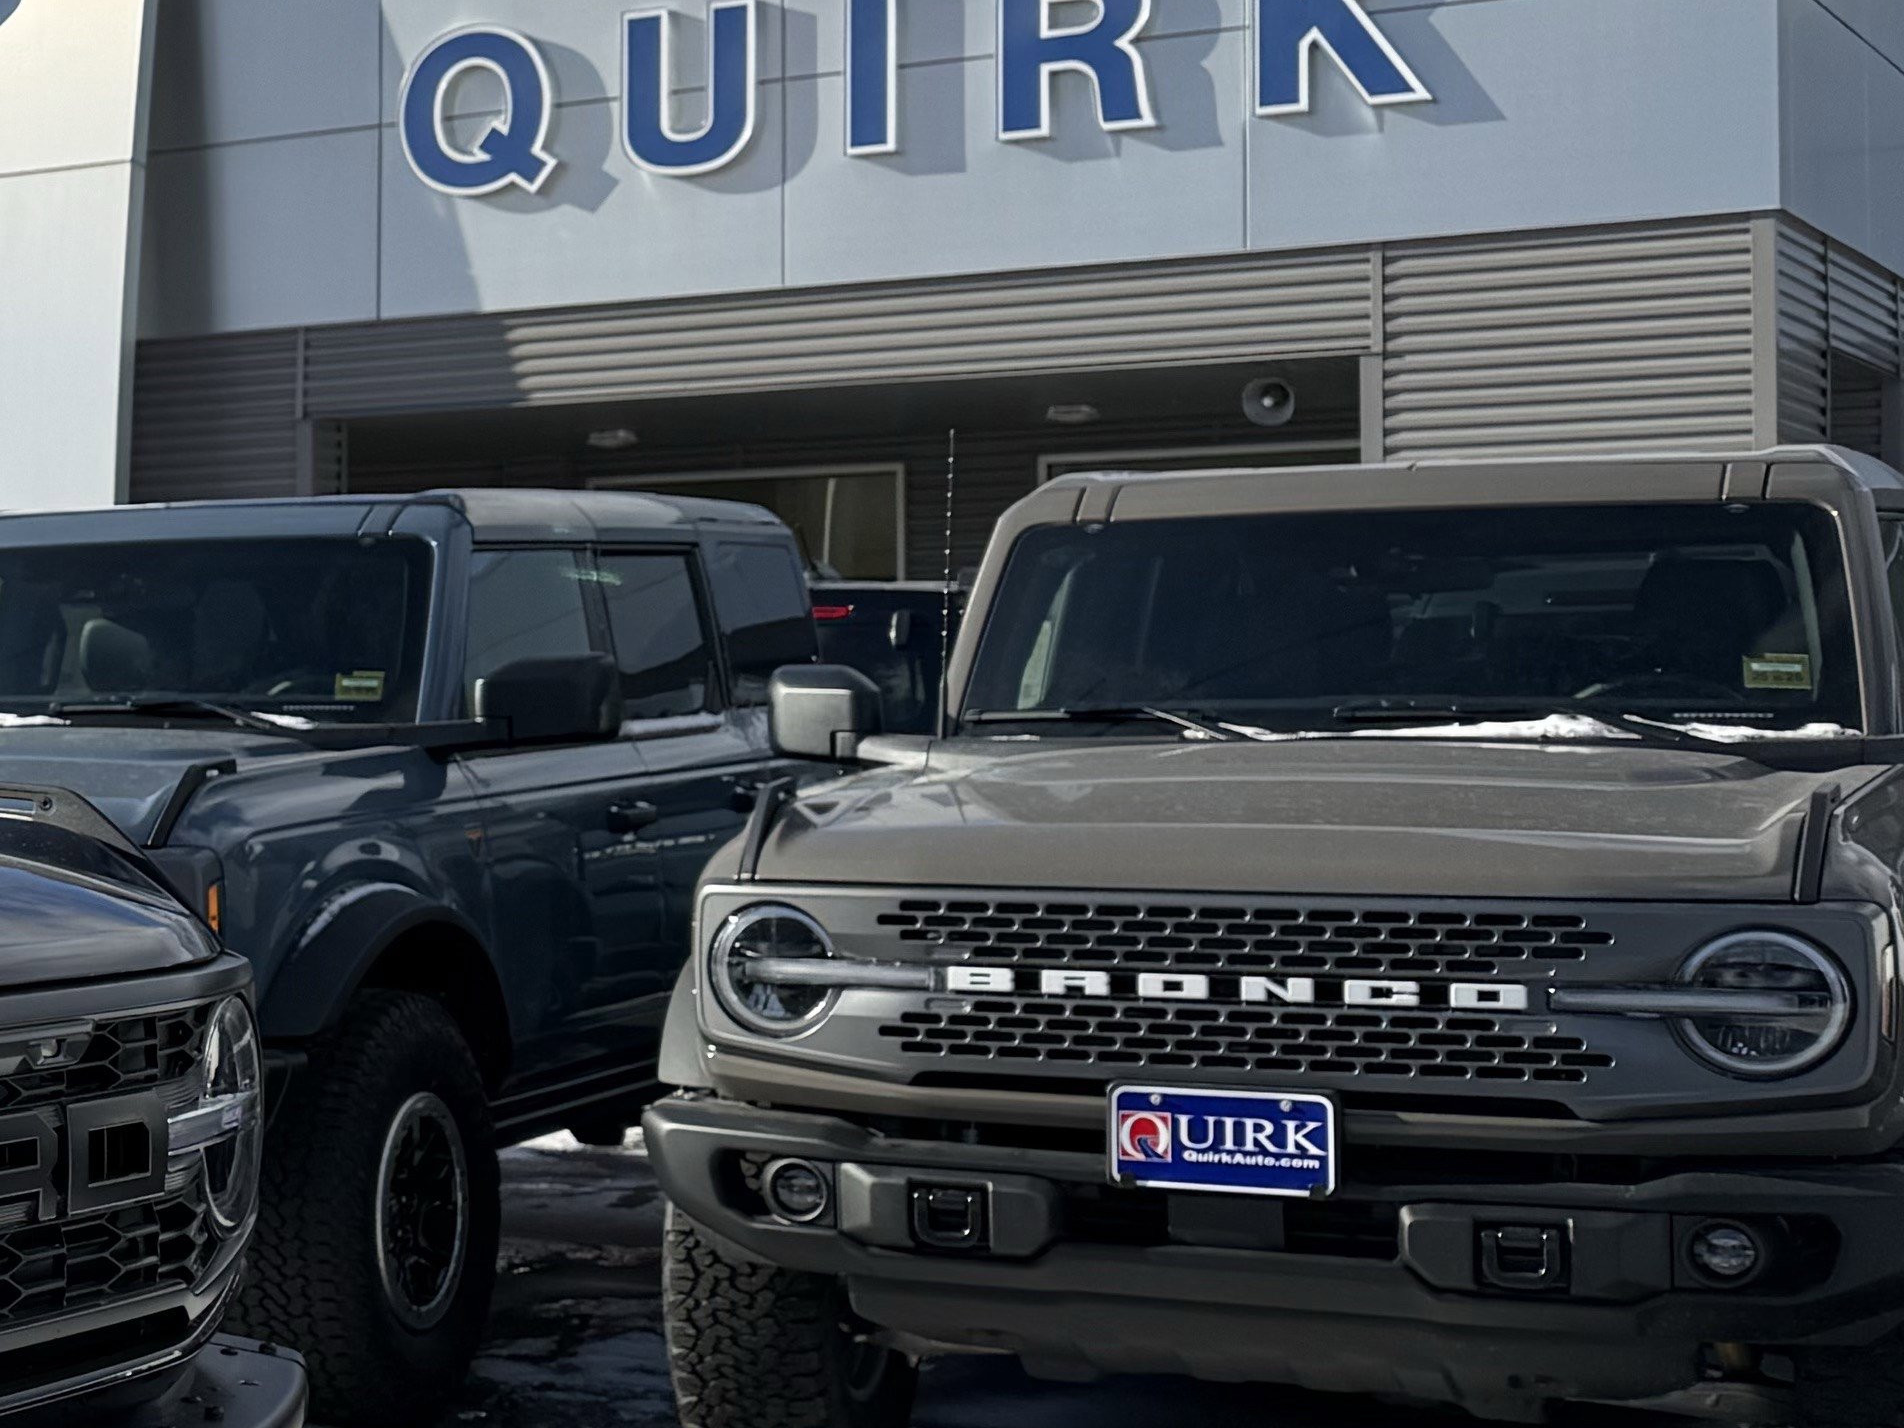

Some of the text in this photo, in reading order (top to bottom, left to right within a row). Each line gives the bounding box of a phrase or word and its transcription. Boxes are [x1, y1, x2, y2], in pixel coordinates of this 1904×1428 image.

[946, 965, 1528, 1010] BRONCO
[1119, 1111, 1328, 1162] QUIRK
[1182, 1149, 1321, 1170] QuirkAuto.com
